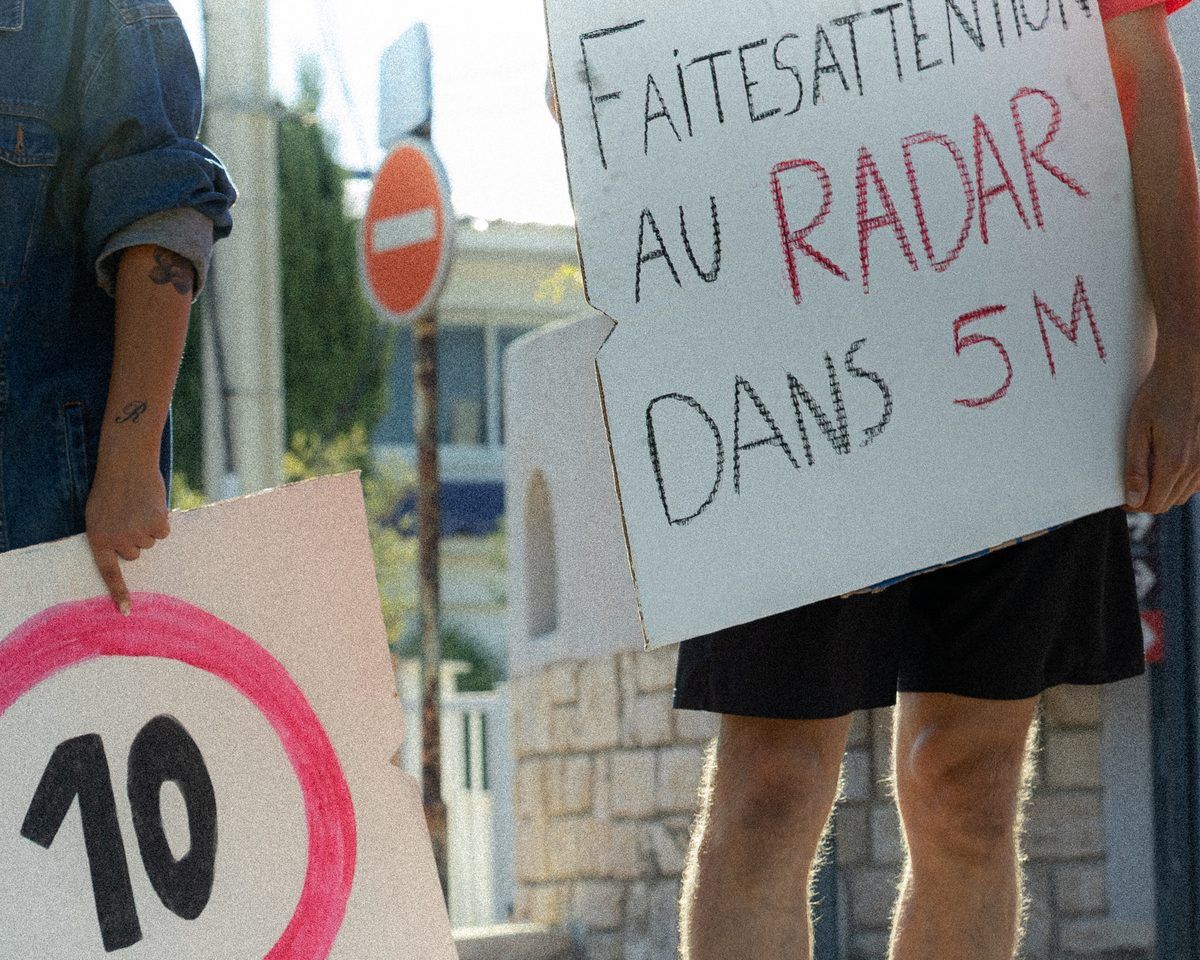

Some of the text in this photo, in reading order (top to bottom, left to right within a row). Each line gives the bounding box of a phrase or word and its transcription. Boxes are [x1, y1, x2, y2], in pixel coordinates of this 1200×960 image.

[634, 86, 1089, 305] AU RADAR
[645, 275, 1107, 526] DANS 5 M
[20, 713, 218, 953] 10
